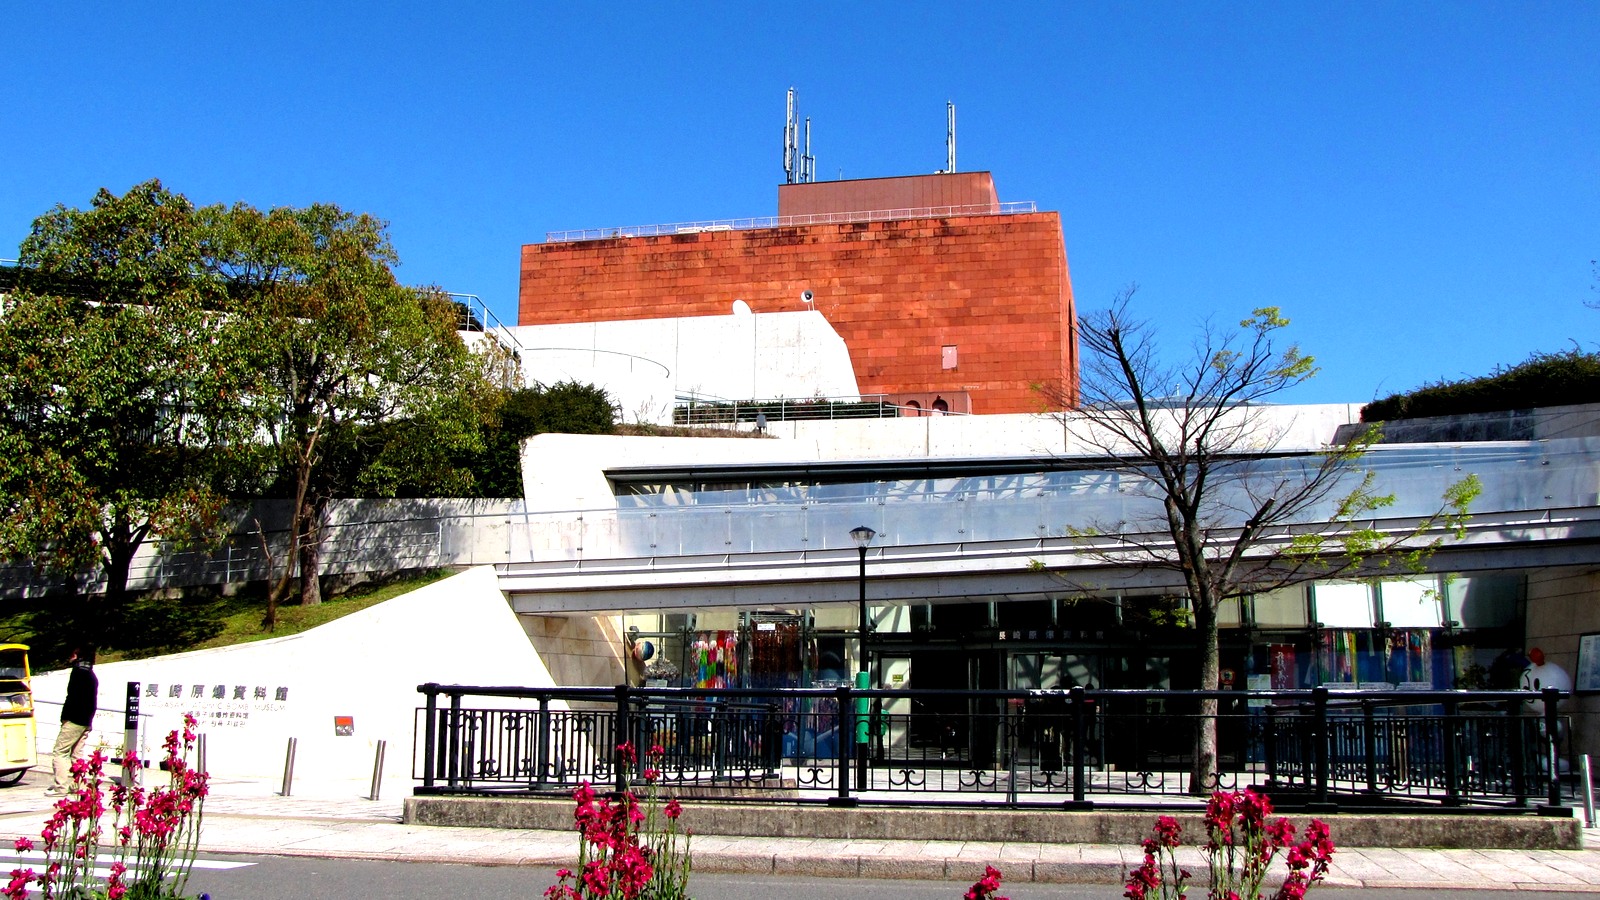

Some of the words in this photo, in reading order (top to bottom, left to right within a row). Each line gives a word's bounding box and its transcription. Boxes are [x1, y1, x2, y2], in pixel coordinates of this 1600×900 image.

[999, 630, 1104, 640] 長崎原爆資料館
[145, 684, 288, 701] 長崎原爆資料館
[192, 702, 222, 710] ATOMIC
[227, 702, 249, 711] BOMB
[254, 703, 286, 712] MUSEUM
